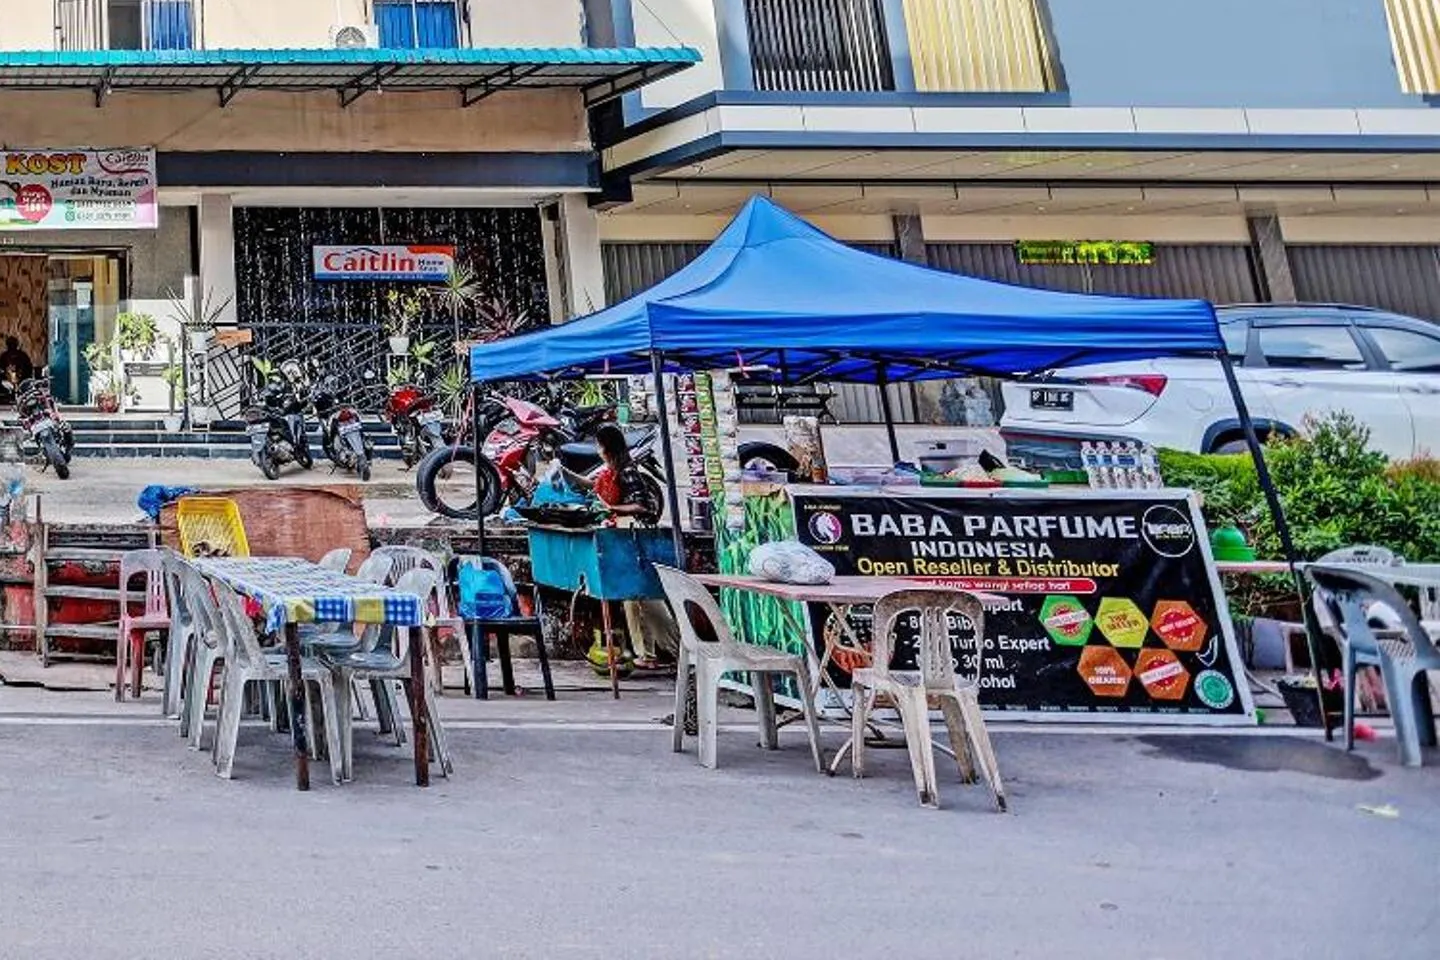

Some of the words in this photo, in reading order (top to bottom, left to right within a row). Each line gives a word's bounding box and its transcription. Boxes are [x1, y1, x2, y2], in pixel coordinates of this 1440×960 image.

[5, 153, 87, 176] KOST
[323, 252, 415, 271] Caitlin
[850, 514, 953, 536] BABA
[963, 515, 1139, 538] PARFUME
[911, 541, 1055, 558] INDONESIA
[857, 557, 909, 577] Open
[913, 558, 991, 576] Reseller
[997, 559, 1011, 575] &
[1016, 559, 1120, 577] Distributor
[998, 635, 1051, 653] Expert
[985, 654, 1005, 669] ml
